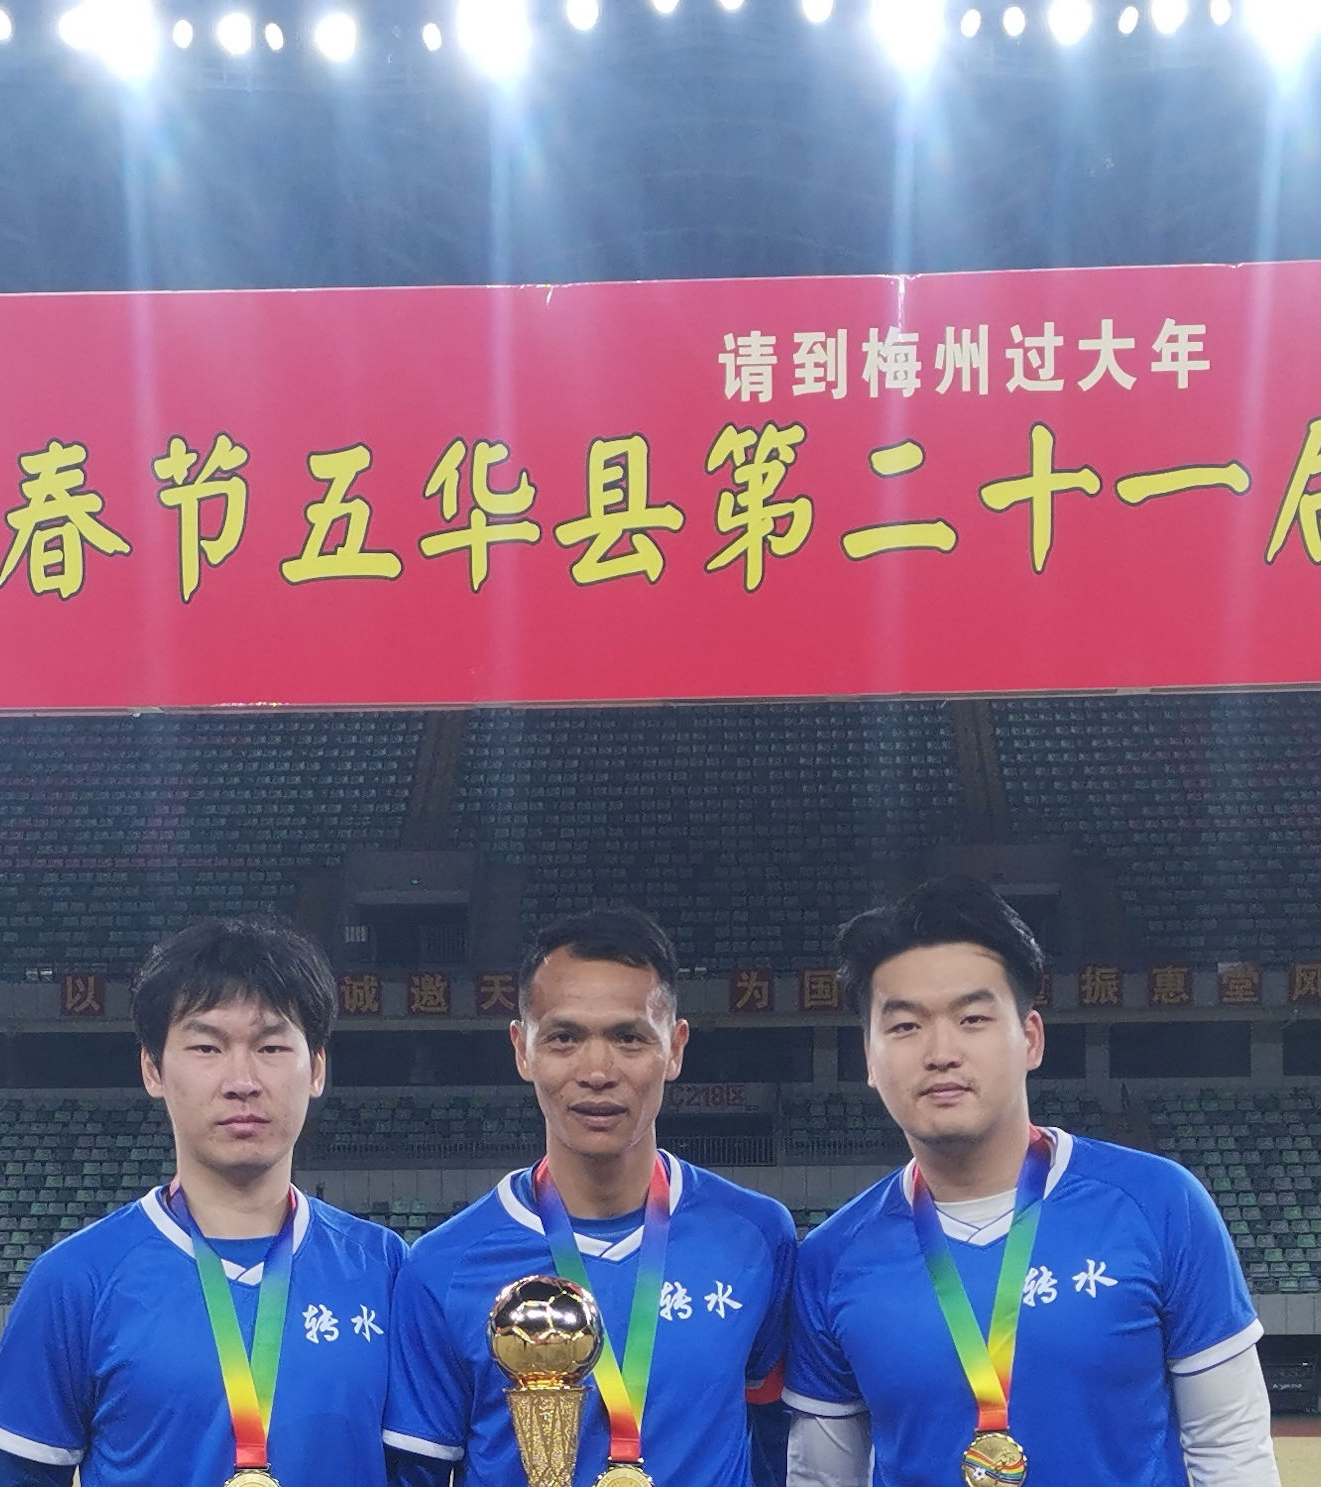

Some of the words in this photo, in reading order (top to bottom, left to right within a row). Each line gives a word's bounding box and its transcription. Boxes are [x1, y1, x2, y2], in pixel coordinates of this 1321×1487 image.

[718, 317, 1211, 403] 请到梅州过大年
[340, 973, 517, 1013] 诚邀天
[734, 970, 839, 1010] 为国
[659, 1279, 743, 1321] 转水
[1022, 1258, 1119, 1308] 转水
[301, 1303, 385, 1344] 转水
